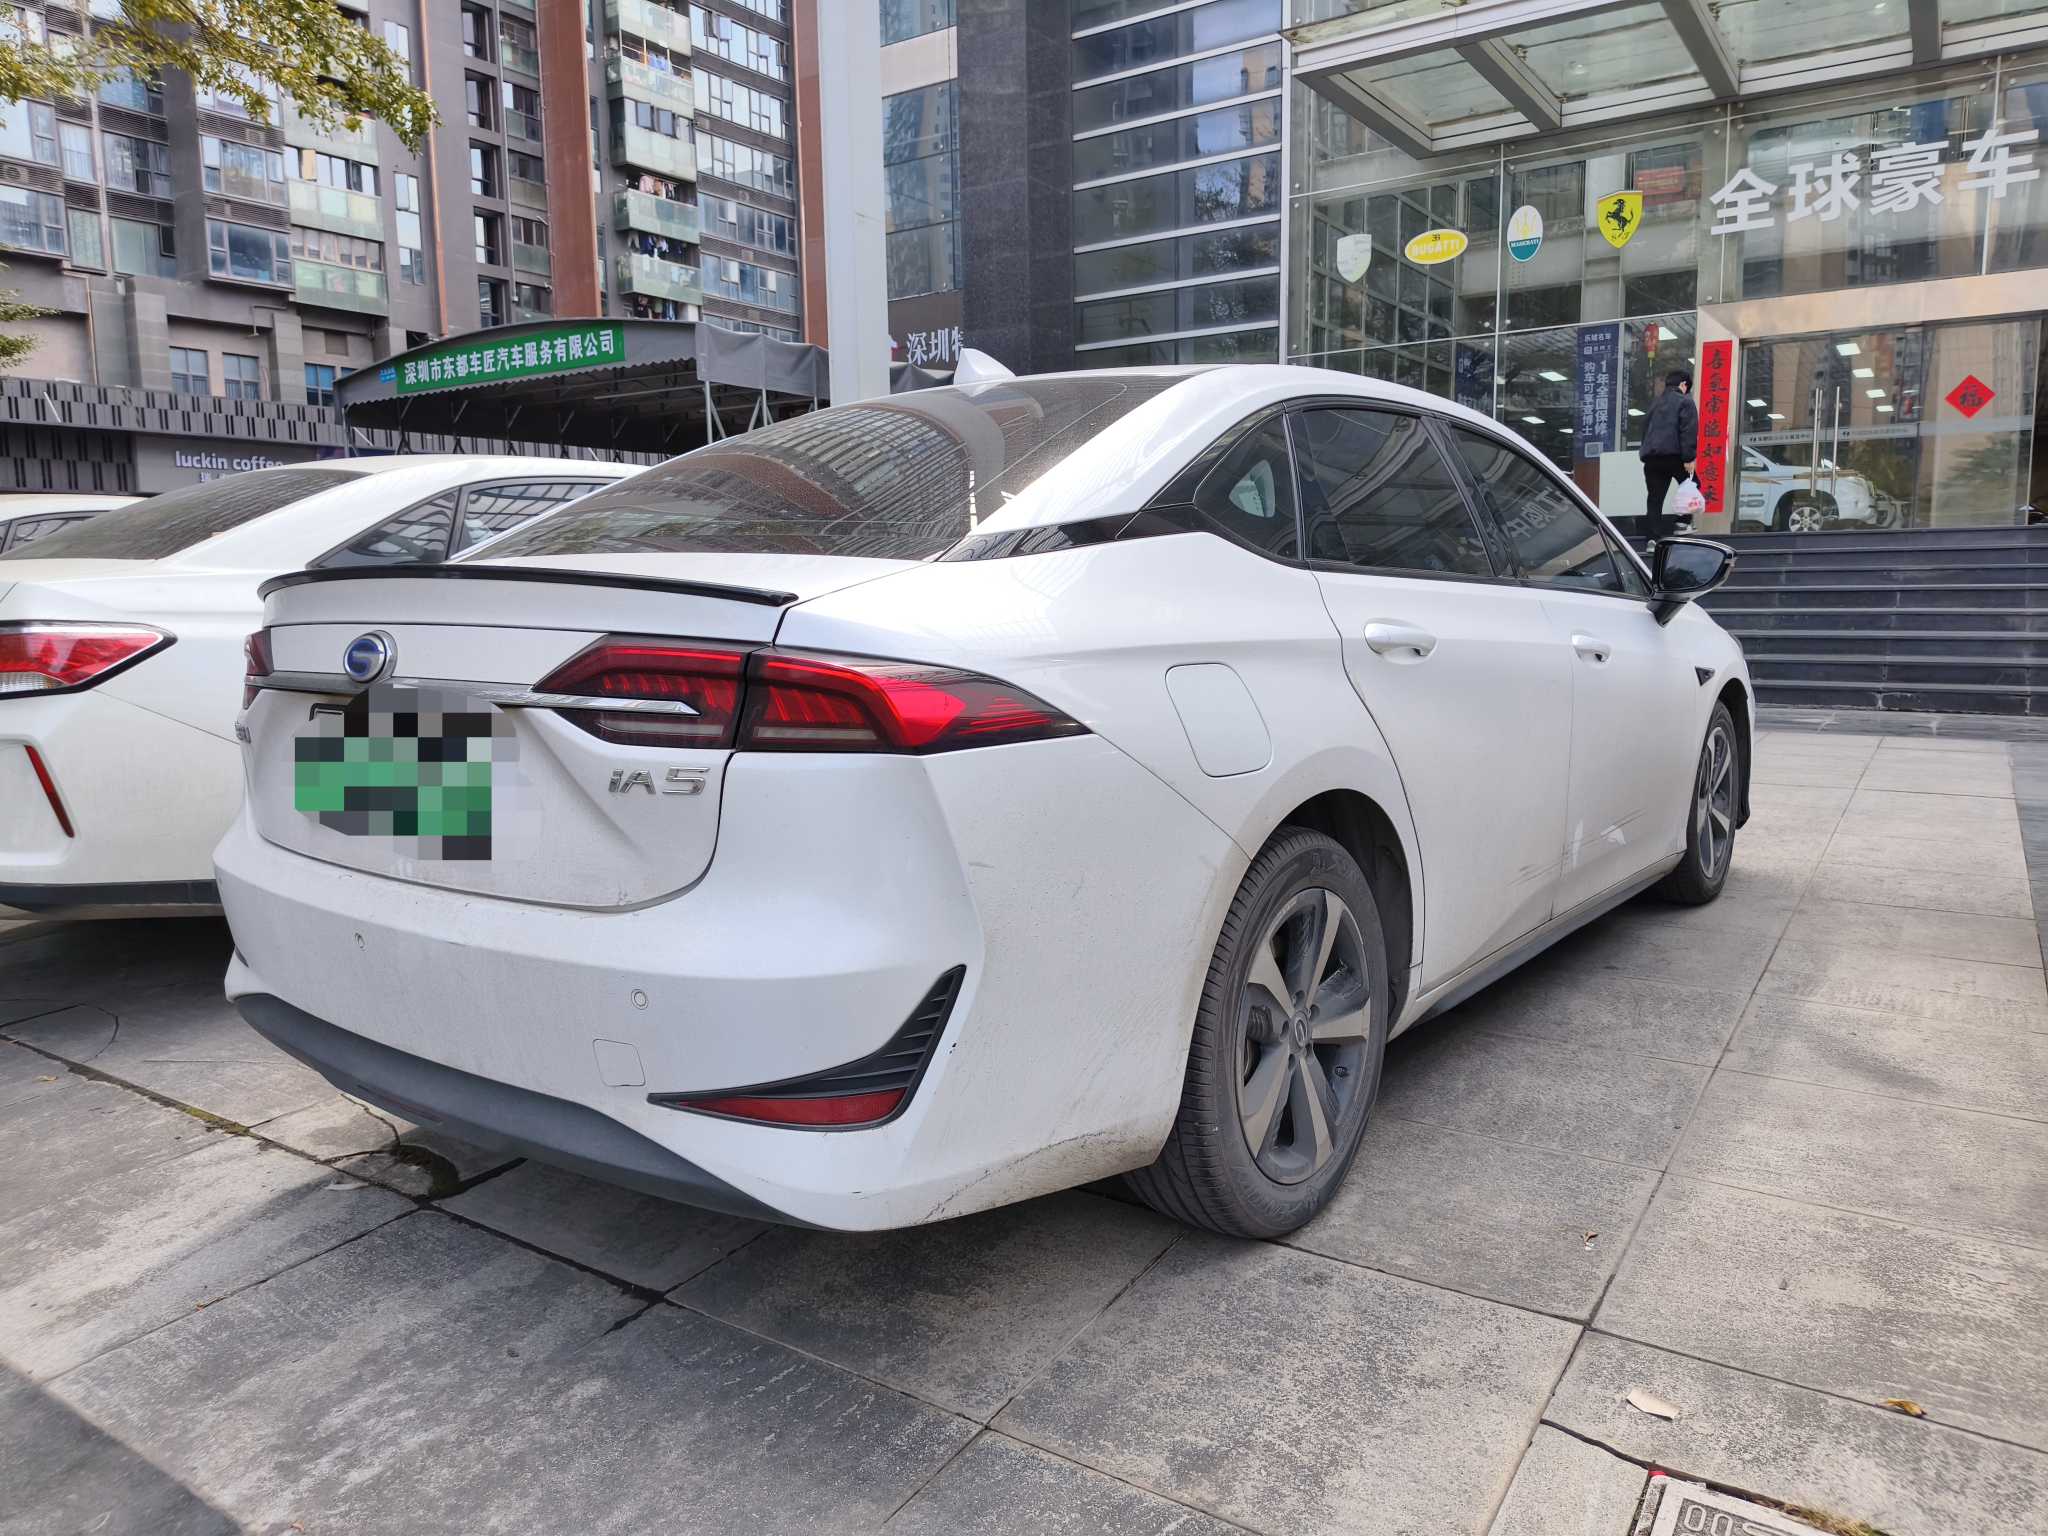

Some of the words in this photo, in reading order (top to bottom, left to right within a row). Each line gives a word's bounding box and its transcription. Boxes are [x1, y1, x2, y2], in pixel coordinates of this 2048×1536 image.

[1709, 128, 2040, 236] 全球豪车
[404, 329, 614, 385] 深圳市东都车匠汽车服务有限公司
[175, 451, 228, 469] luckin
